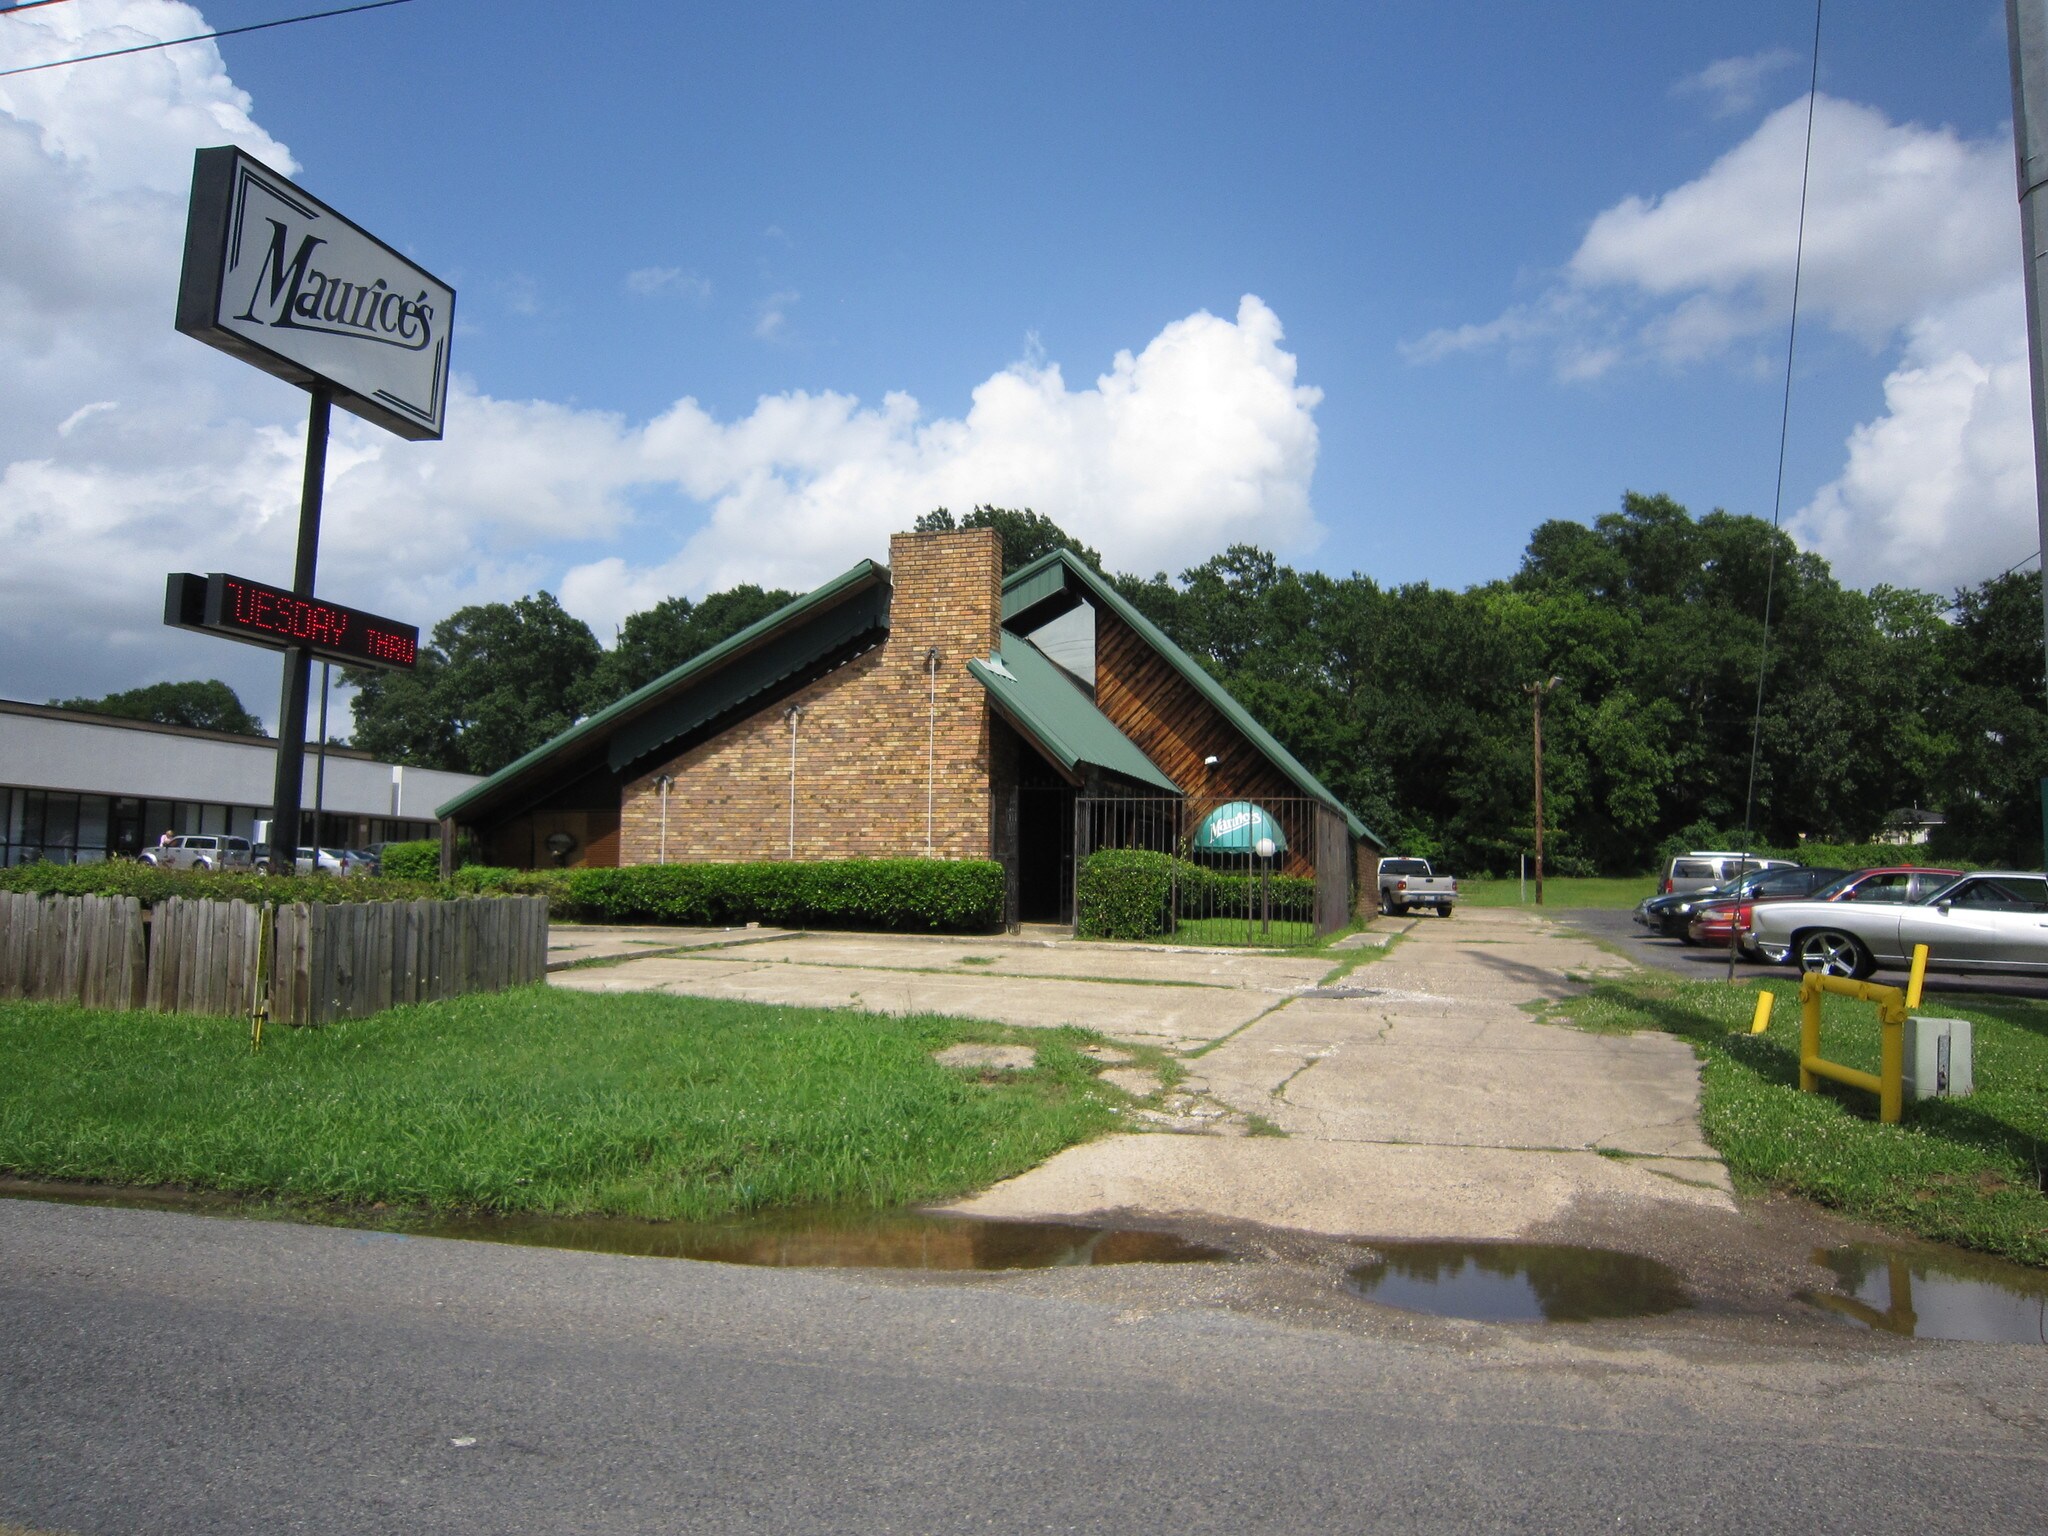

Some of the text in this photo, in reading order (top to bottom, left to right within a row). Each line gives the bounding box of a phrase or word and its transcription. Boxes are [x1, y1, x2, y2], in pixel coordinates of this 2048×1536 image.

[233, 216, 434, 352] Maurice's
[228, 582, 413, 663] UESDAY THRU
